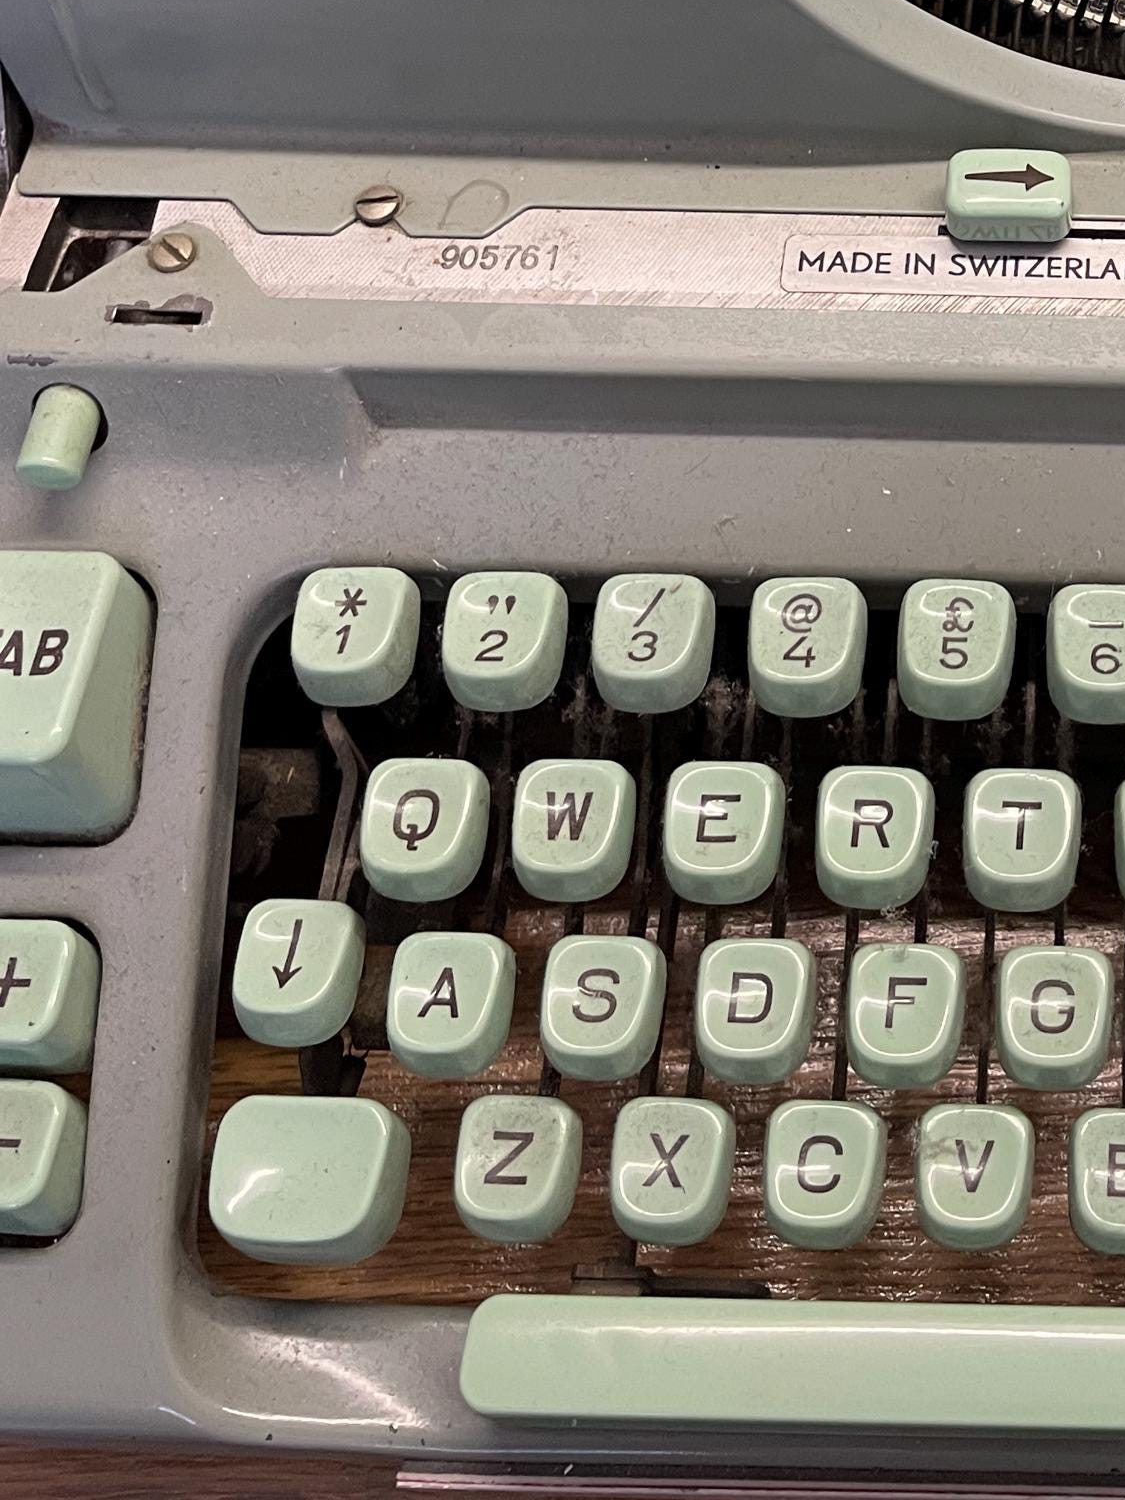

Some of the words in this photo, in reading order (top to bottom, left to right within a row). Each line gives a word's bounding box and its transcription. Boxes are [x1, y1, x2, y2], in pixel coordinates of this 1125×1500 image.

[439, 245, 558, 271] 905761
[799, 251, 892, 273] MADE
[905, 253, 935, 275] IN
[783, 594, 822, 633] @
[336, 625, 351, 654] 1
[475, 630, 508, 661] 2
[628, 631, 658, 661] 3
[783, 636, 816, 668] 4
[940, 637, 968, 669] 5
[1091, 643, 1122, 674] 6
[393, 790, 439, 851] Q
[547, 792, 593, 840] W
[696, 795, 741, 843] E
[851, 800, 889, 848] R
[1002, 801, 1042, 850] T
[418, 968, 458, 1018] A
[573, 969, 620, 1023] S
[727, 972, 773, 1023] D
[885, 977, 927, 1028] F
[1031, 980, 1075, 1034] G
[484, 1131, 534, 1185] Z
[643, 1133, 690, 1188] X
[798, 1136, 843, 1193] C
[955, 1140, 994, 1192] V
